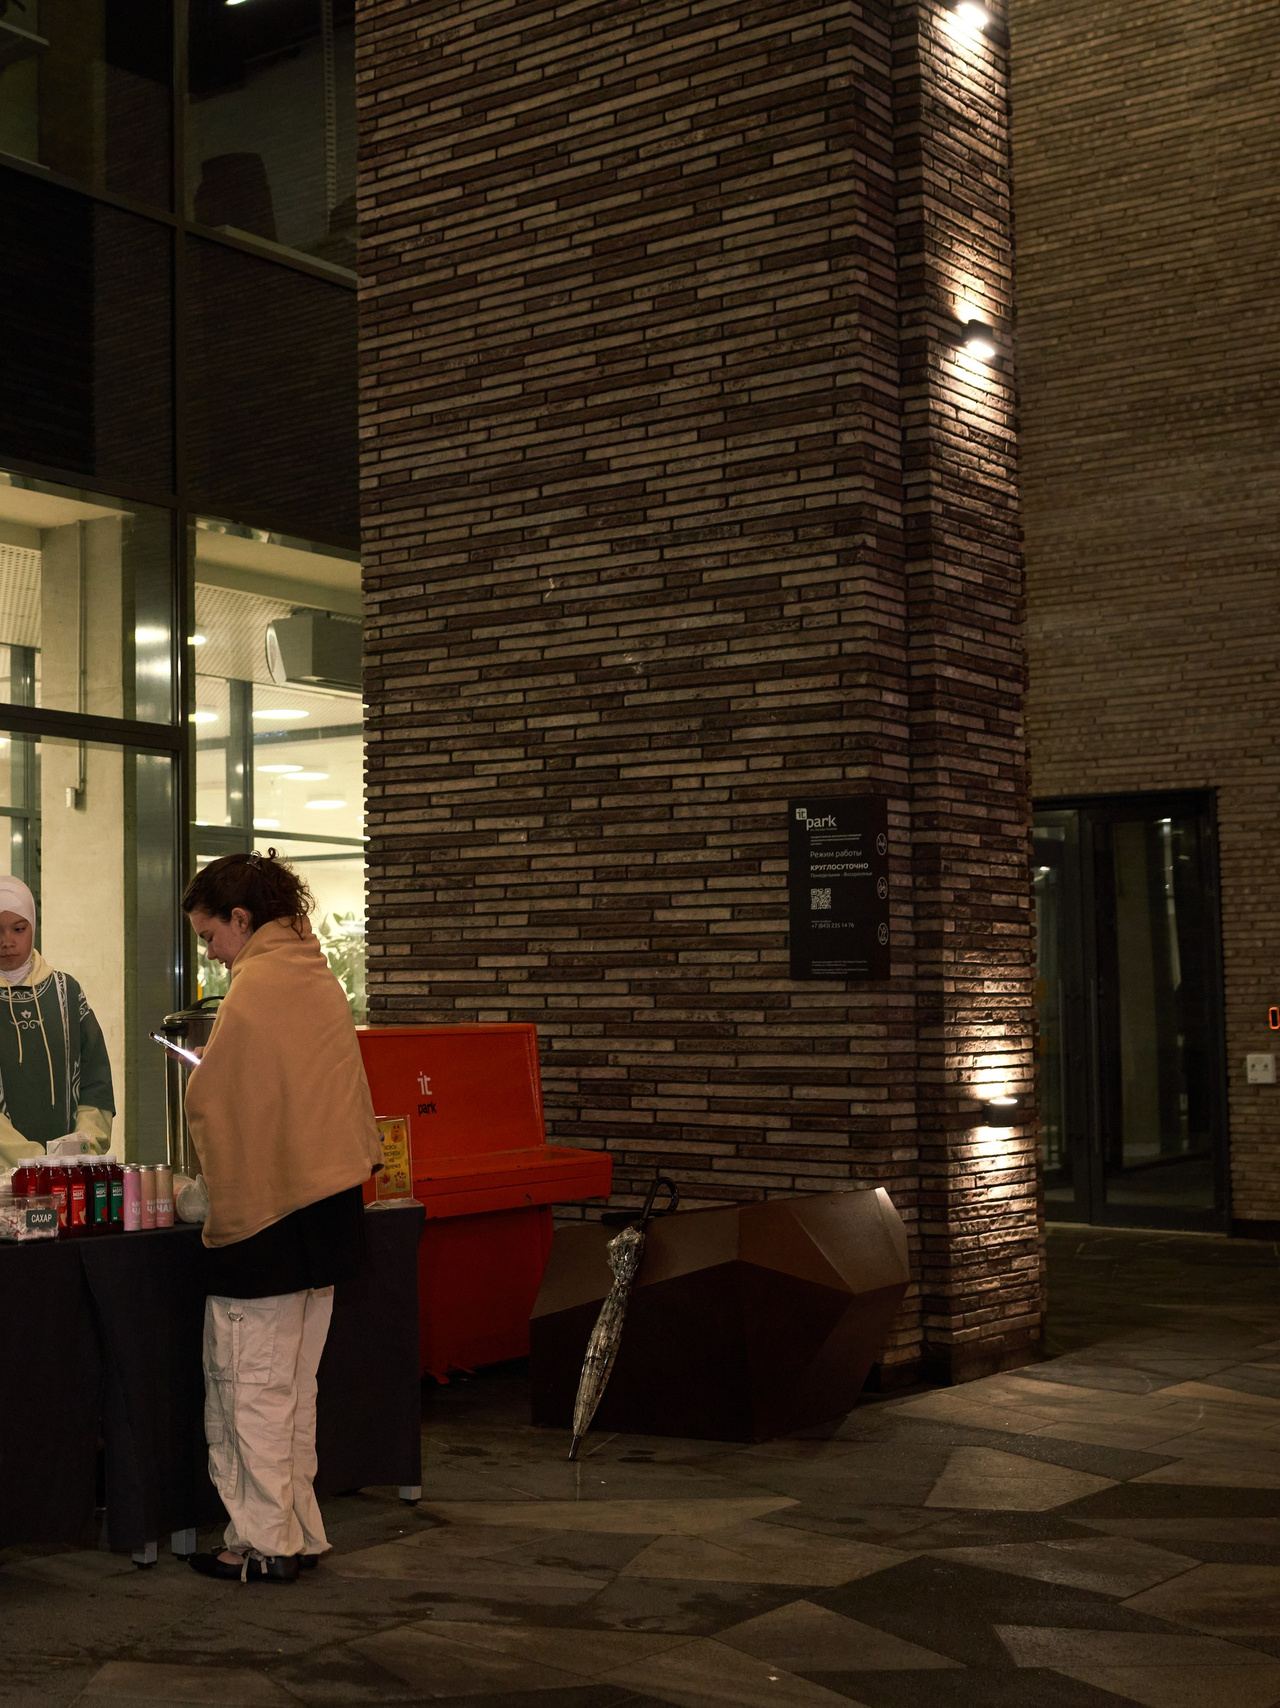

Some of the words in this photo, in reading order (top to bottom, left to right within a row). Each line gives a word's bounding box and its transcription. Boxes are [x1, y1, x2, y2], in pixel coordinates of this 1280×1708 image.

[806, 814, 837, 831] park
[810, 850, 834, 858] Режим
[835, 849, 862, 858] работы
[810, 862, 869, 871] КРУГЛОСУТОЧНО
[417, 1071, 433, 1096] it
[417, 1100, 437, 1117] park
[31, 1213, 52, 1223] САХАР
